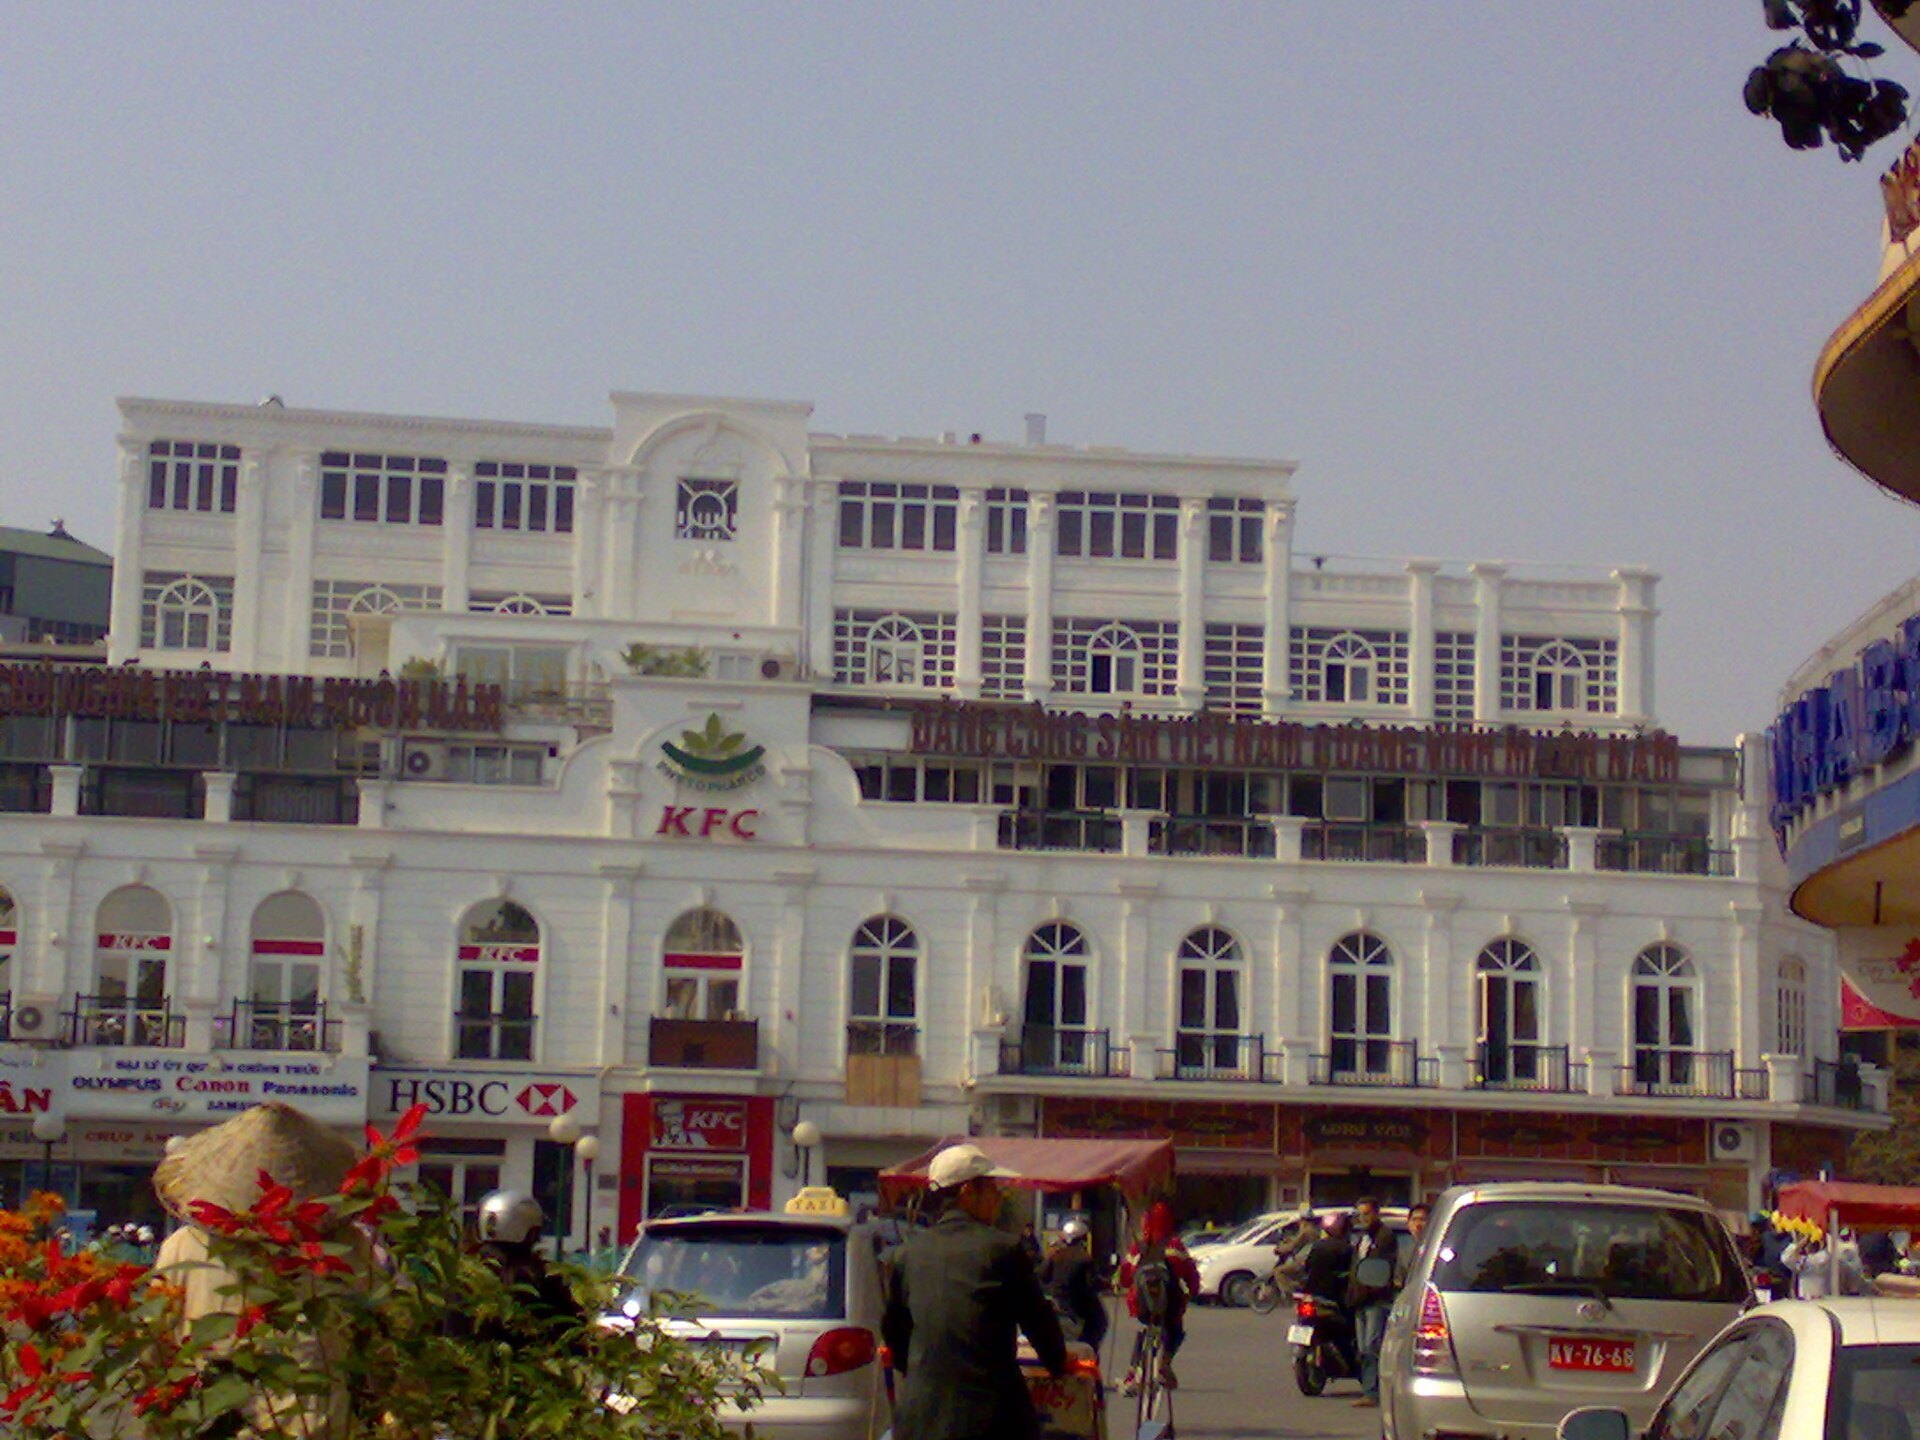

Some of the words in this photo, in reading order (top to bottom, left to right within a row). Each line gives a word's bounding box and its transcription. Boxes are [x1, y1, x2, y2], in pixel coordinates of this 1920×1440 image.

[656, 805, 759, 840] KFC
[114, 934, 158, 950] KFC
[480, 946, 523, 961] KFC
[73, 1076, 161, 1091] OLYMPUS
[176, 1076, 250, 1093] Canon
[263, 1081, 358, 1097] Panasonic
[388, 1078, 509, 1116] HSBC
[688, 1110, 741, 1130] KFC
[795, 1201, 837, 1211] TAXI
